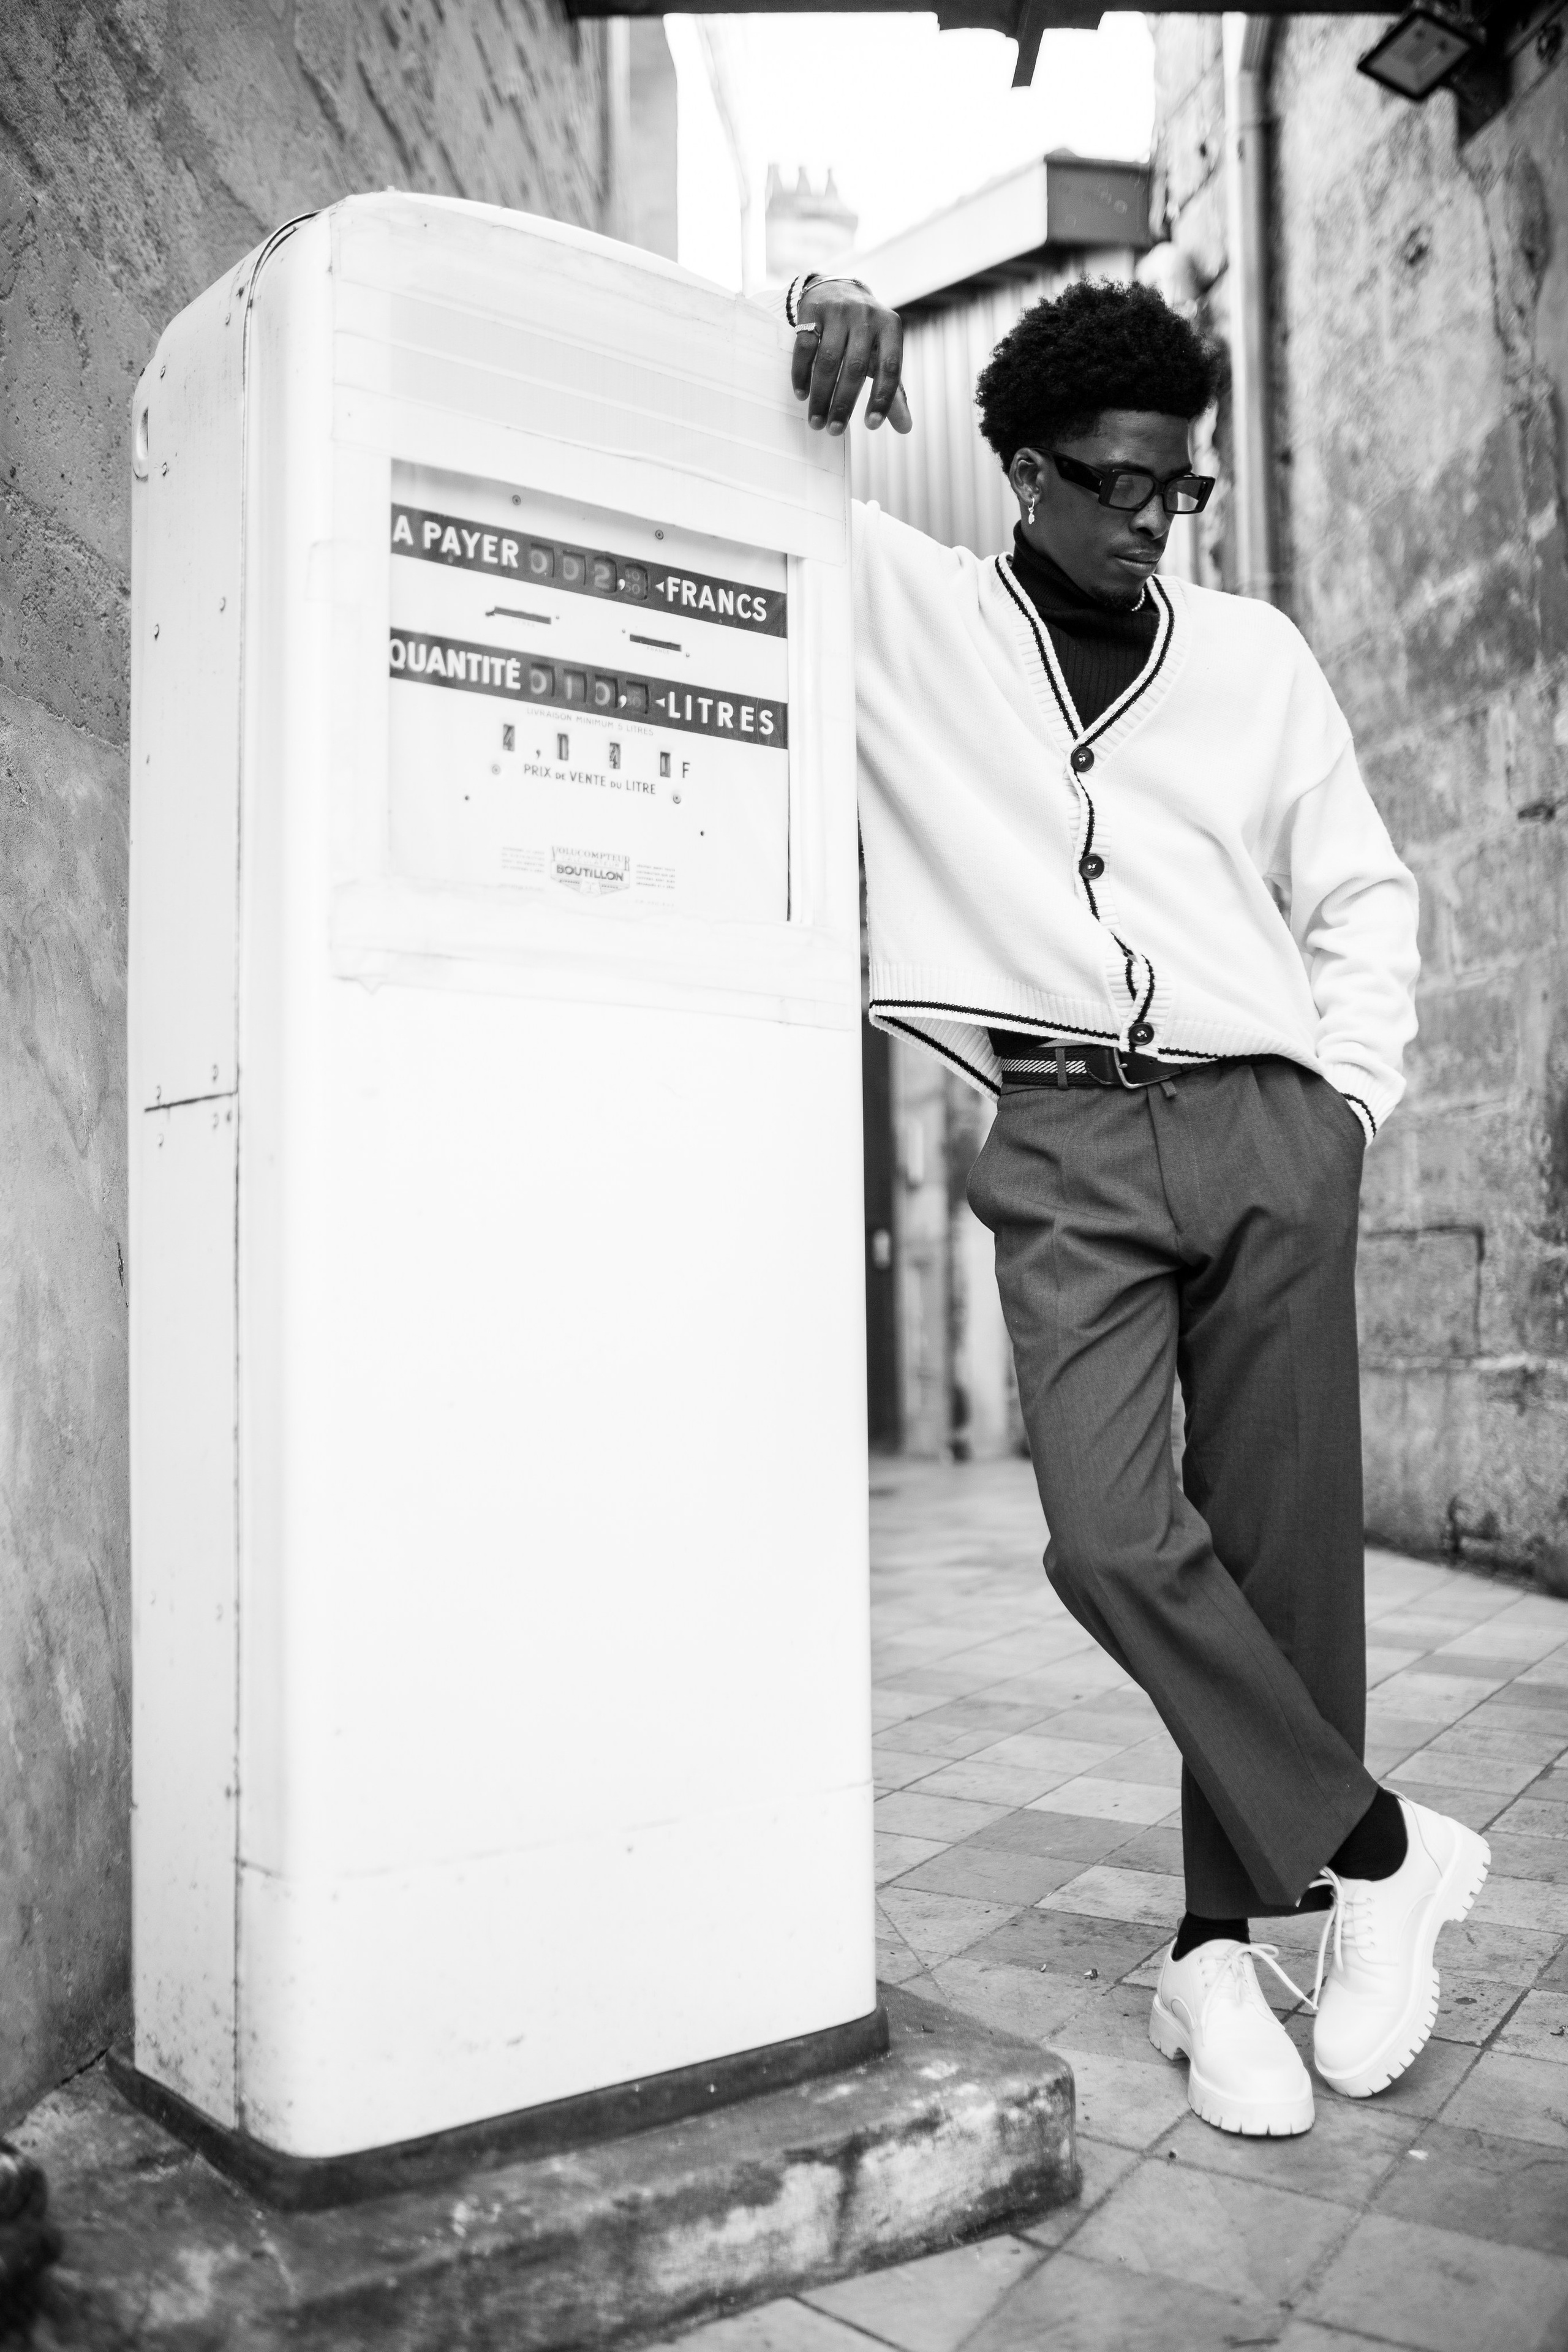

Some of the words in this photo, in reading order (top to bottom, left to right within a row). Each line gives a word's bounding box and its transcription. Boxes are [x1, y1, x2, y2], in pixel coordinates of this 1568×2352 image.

[393, 514, 413, 546] A
[423, 520, 519, 568] PAYER
[666, 576, 767, 622] FRANCS
[390, 638, 521, 690] QUANTITÉ
[668, 691, 774, 735] LITRES
[527, 706, 572, 723] LIVRAISON
[576, 715, 614, 729] MINIMUM
[617, 723, 624, 731] 5
[626, 725, 654, 736] LITRES
[524, 763, 552, 778] PRIX
[570, 771, 606, 787] VENTE
[626, 779, 657, 795] LITRE
[682, 761, 691, 778] F
[551, 845, 630, 871] VOLUCOMPTEUR
[556, 864, 624, 882] BOUTILLON
